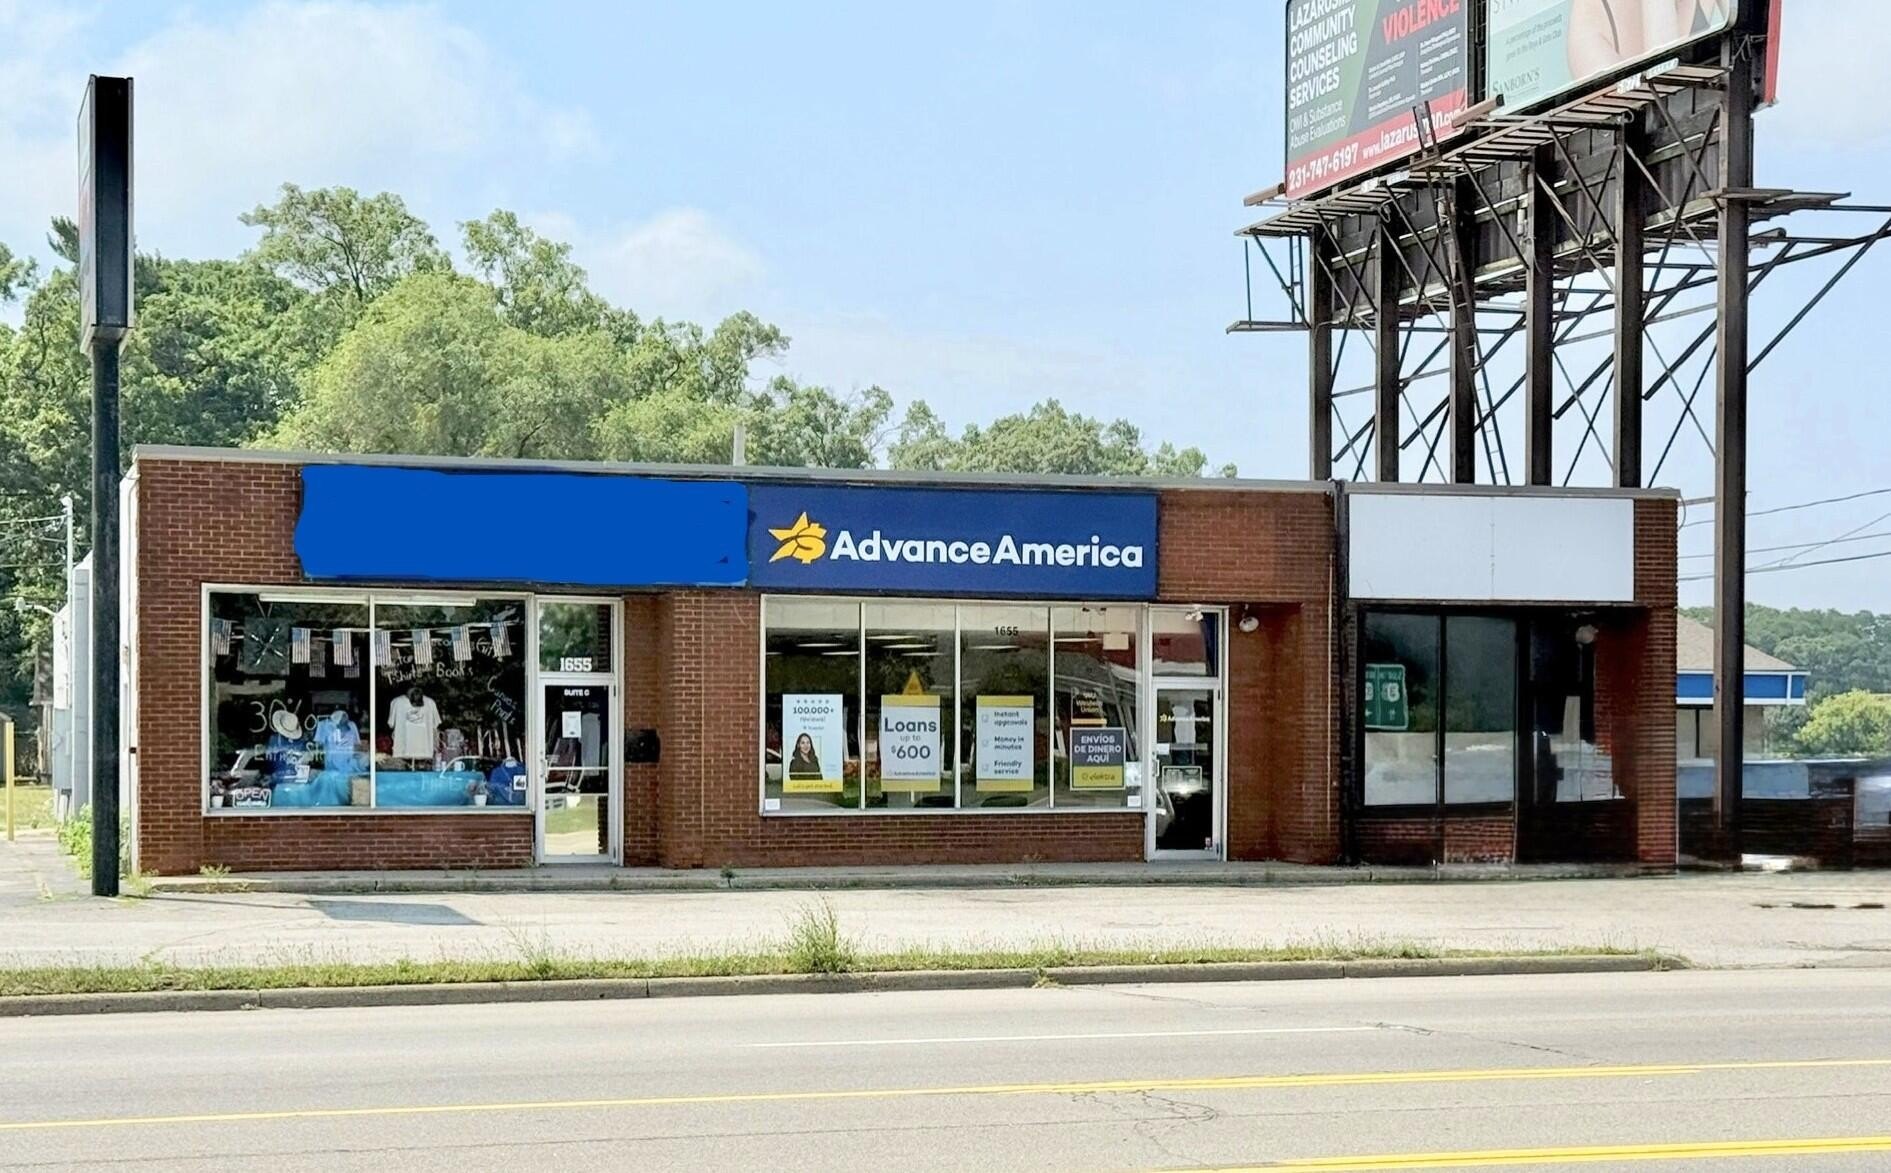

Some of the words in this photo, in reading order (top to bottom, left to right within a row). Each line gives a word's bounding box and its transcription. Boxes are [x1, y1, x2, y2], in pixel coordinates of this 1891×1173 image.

[1290, 4, 1356, 57] COMMUNITY
[1383, 0, 1460, 45] VIOLENCE
[1290, 32, 1358, 83] COUNSELING
[1289, 67, 1340, 110] SERVICES
[1303, 112, 1309, 127] &
[1309, 101, 1343, 124] Substance
[1290, 132, 1309, 150] Abuse
[1310, 115, 1346, 141] Evaluations
[1289, 142, 1359, 191] 231-747-6197
[994, 625, 1019, 637] 1655
[560, 657, 593, 672] 1655
[884, 717, 937, 733] Loans
[1080, 733, 1116, 744] ENVÍOS
[891, 744, 931, 760] $600
[1074, 745, 1086, 753] DE
[1088, 745, 1122, 753] DINERO
[994, 760, 1022, 768] Friendly
[1086, 753, 1110, 763] AQUÍ
[235, 788, 269, 800] OPEN
